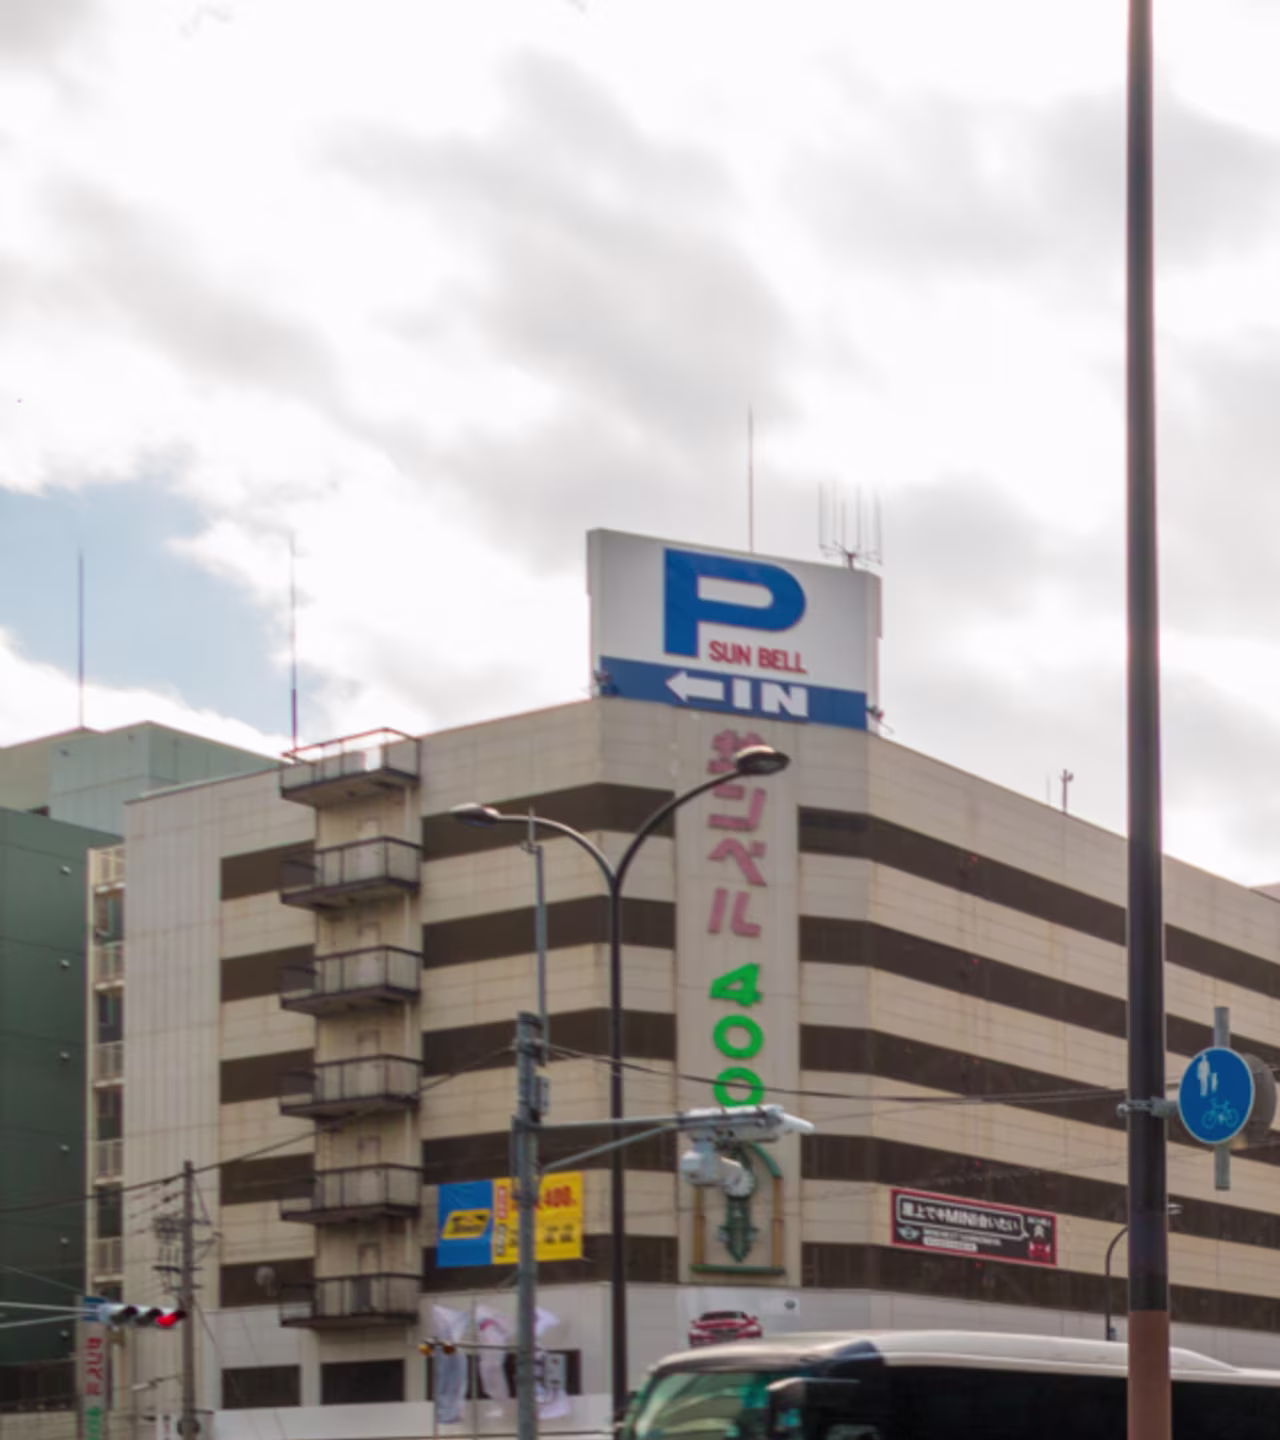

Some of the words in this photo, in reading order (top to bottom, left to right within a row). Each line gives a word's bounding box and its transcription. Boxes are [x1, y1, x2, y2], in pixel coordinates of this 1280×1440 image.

[664, 547, 807, 658] P
[708, 640, 752, 667] SUN
[757, 646, 808, 674] BELL
[732, 676, 809, 718] IN
[709, 963, 764, 1108] 400
